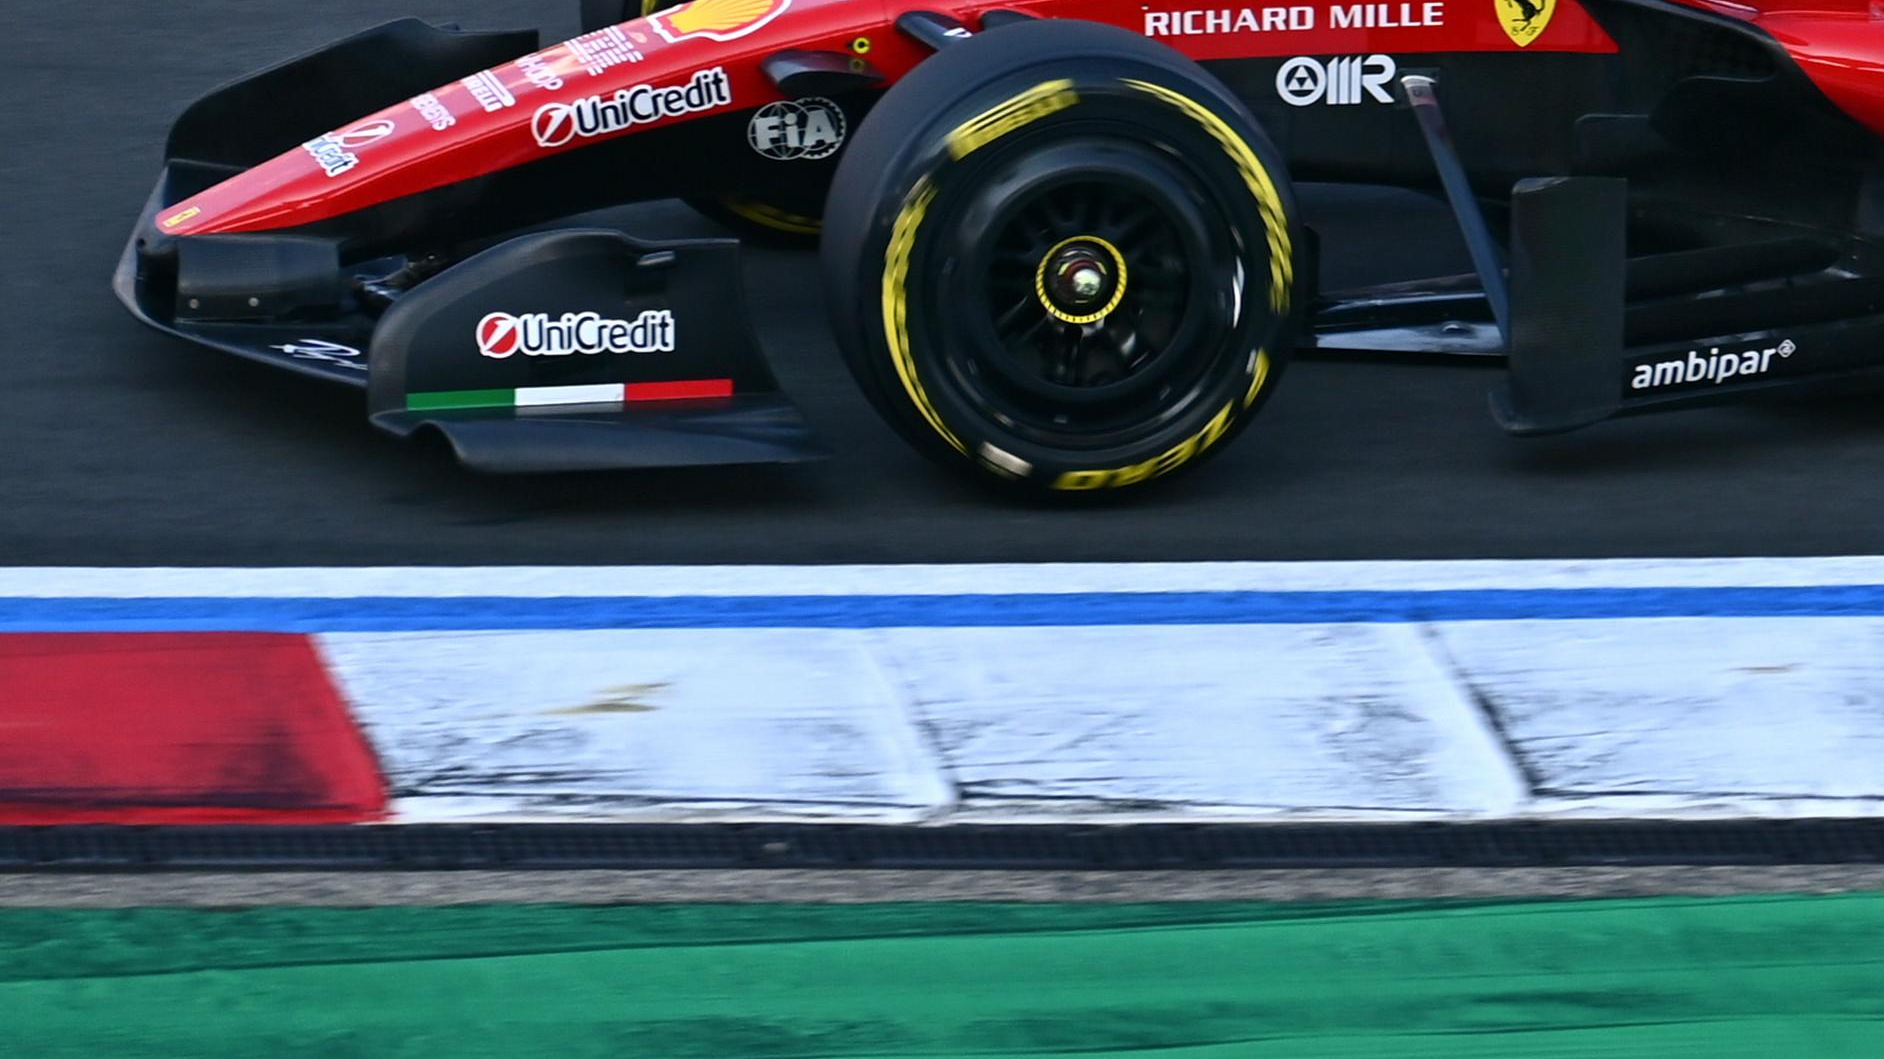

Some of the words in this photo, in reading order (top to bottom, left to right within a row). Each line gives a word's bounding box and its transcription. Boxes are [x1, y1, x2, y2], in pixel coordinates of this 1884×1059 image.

[1144, 8, 1316, 38] RICHARD
[1328, 1, 1445, 29] MILLE
[574, 70, 728, 135] UniCredit
[519, 313, 673, 354] UniCredit
[1631, 347, 1777, 390] ambipar
